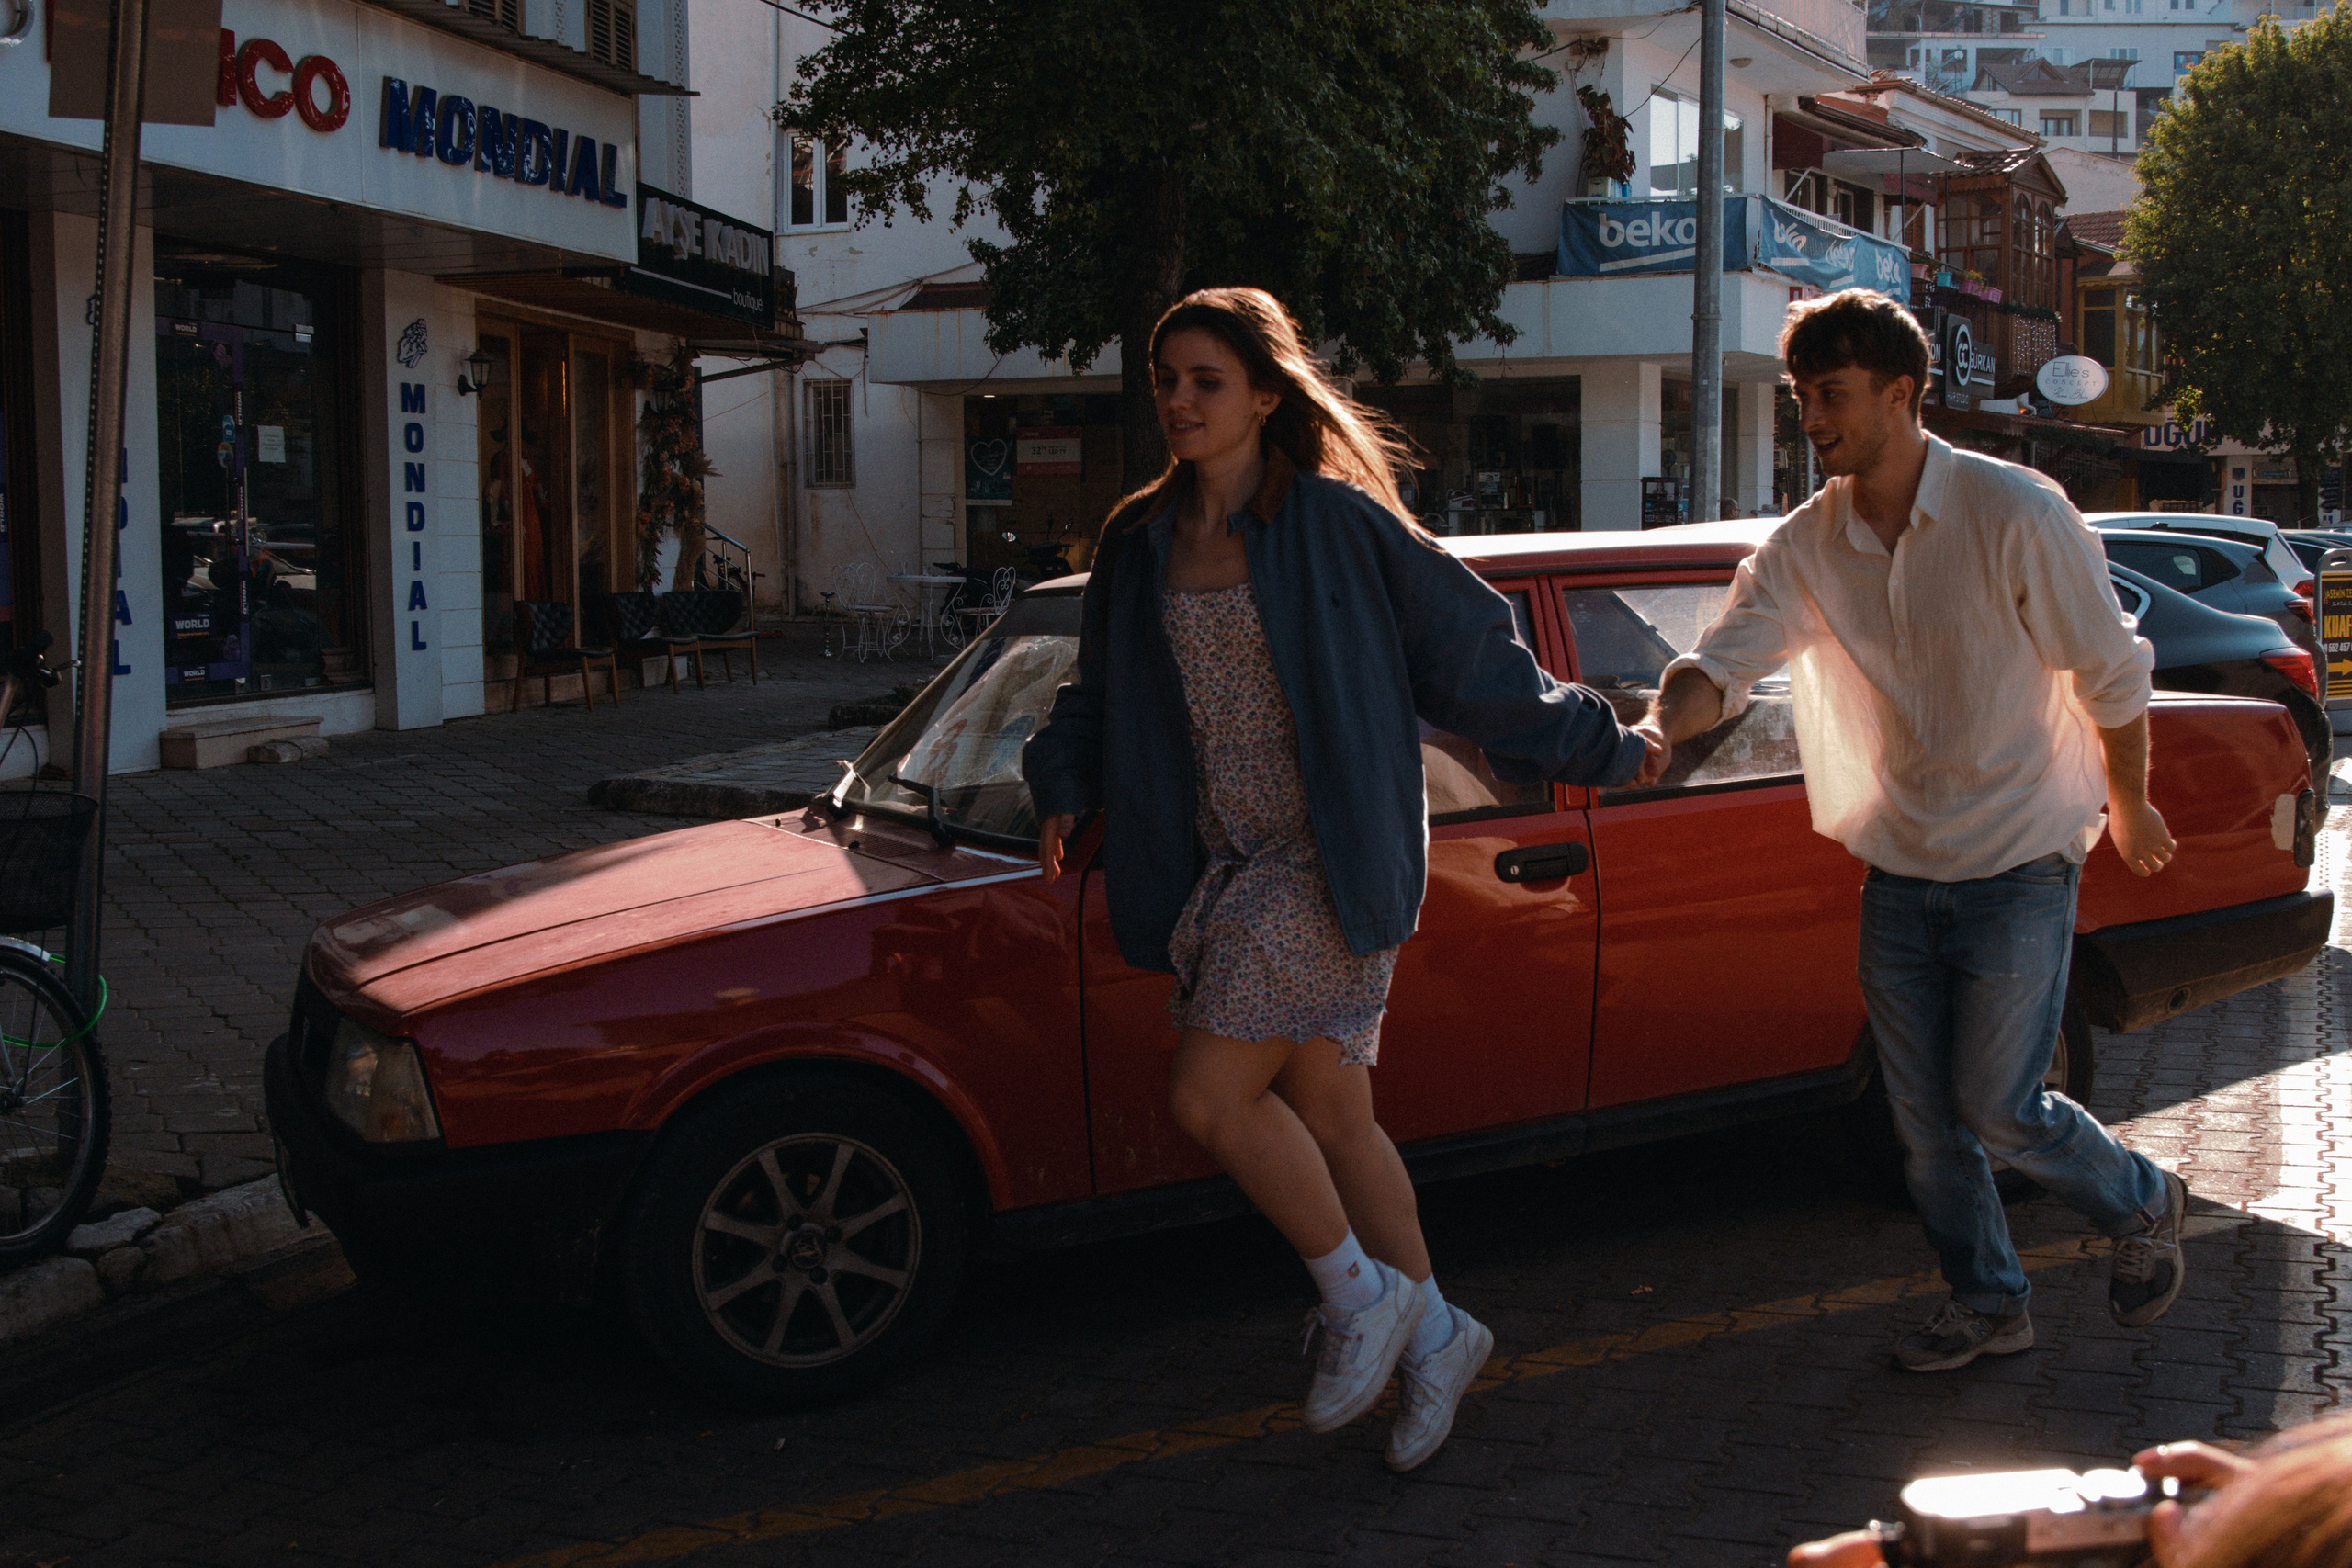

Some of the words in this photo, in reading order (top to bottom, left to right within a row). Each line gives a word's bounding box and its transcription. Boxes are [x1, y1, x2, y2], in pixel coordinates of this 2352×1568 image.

[379, 76, 628, 209] MONDIAL
[1599, 211, 1697, 248] beko
[703, 218, 769, 276] KADIN
[732, 287, 763, 313] boutique
[175, 323, 198, 333] WORLD
[2045, 378, 2098, 387] CONCEPT
[401, 382, 428, 651] MONDIAL
[175, 618, 209, 630] WORLD
[183, 669, 206, 677] WORLD
